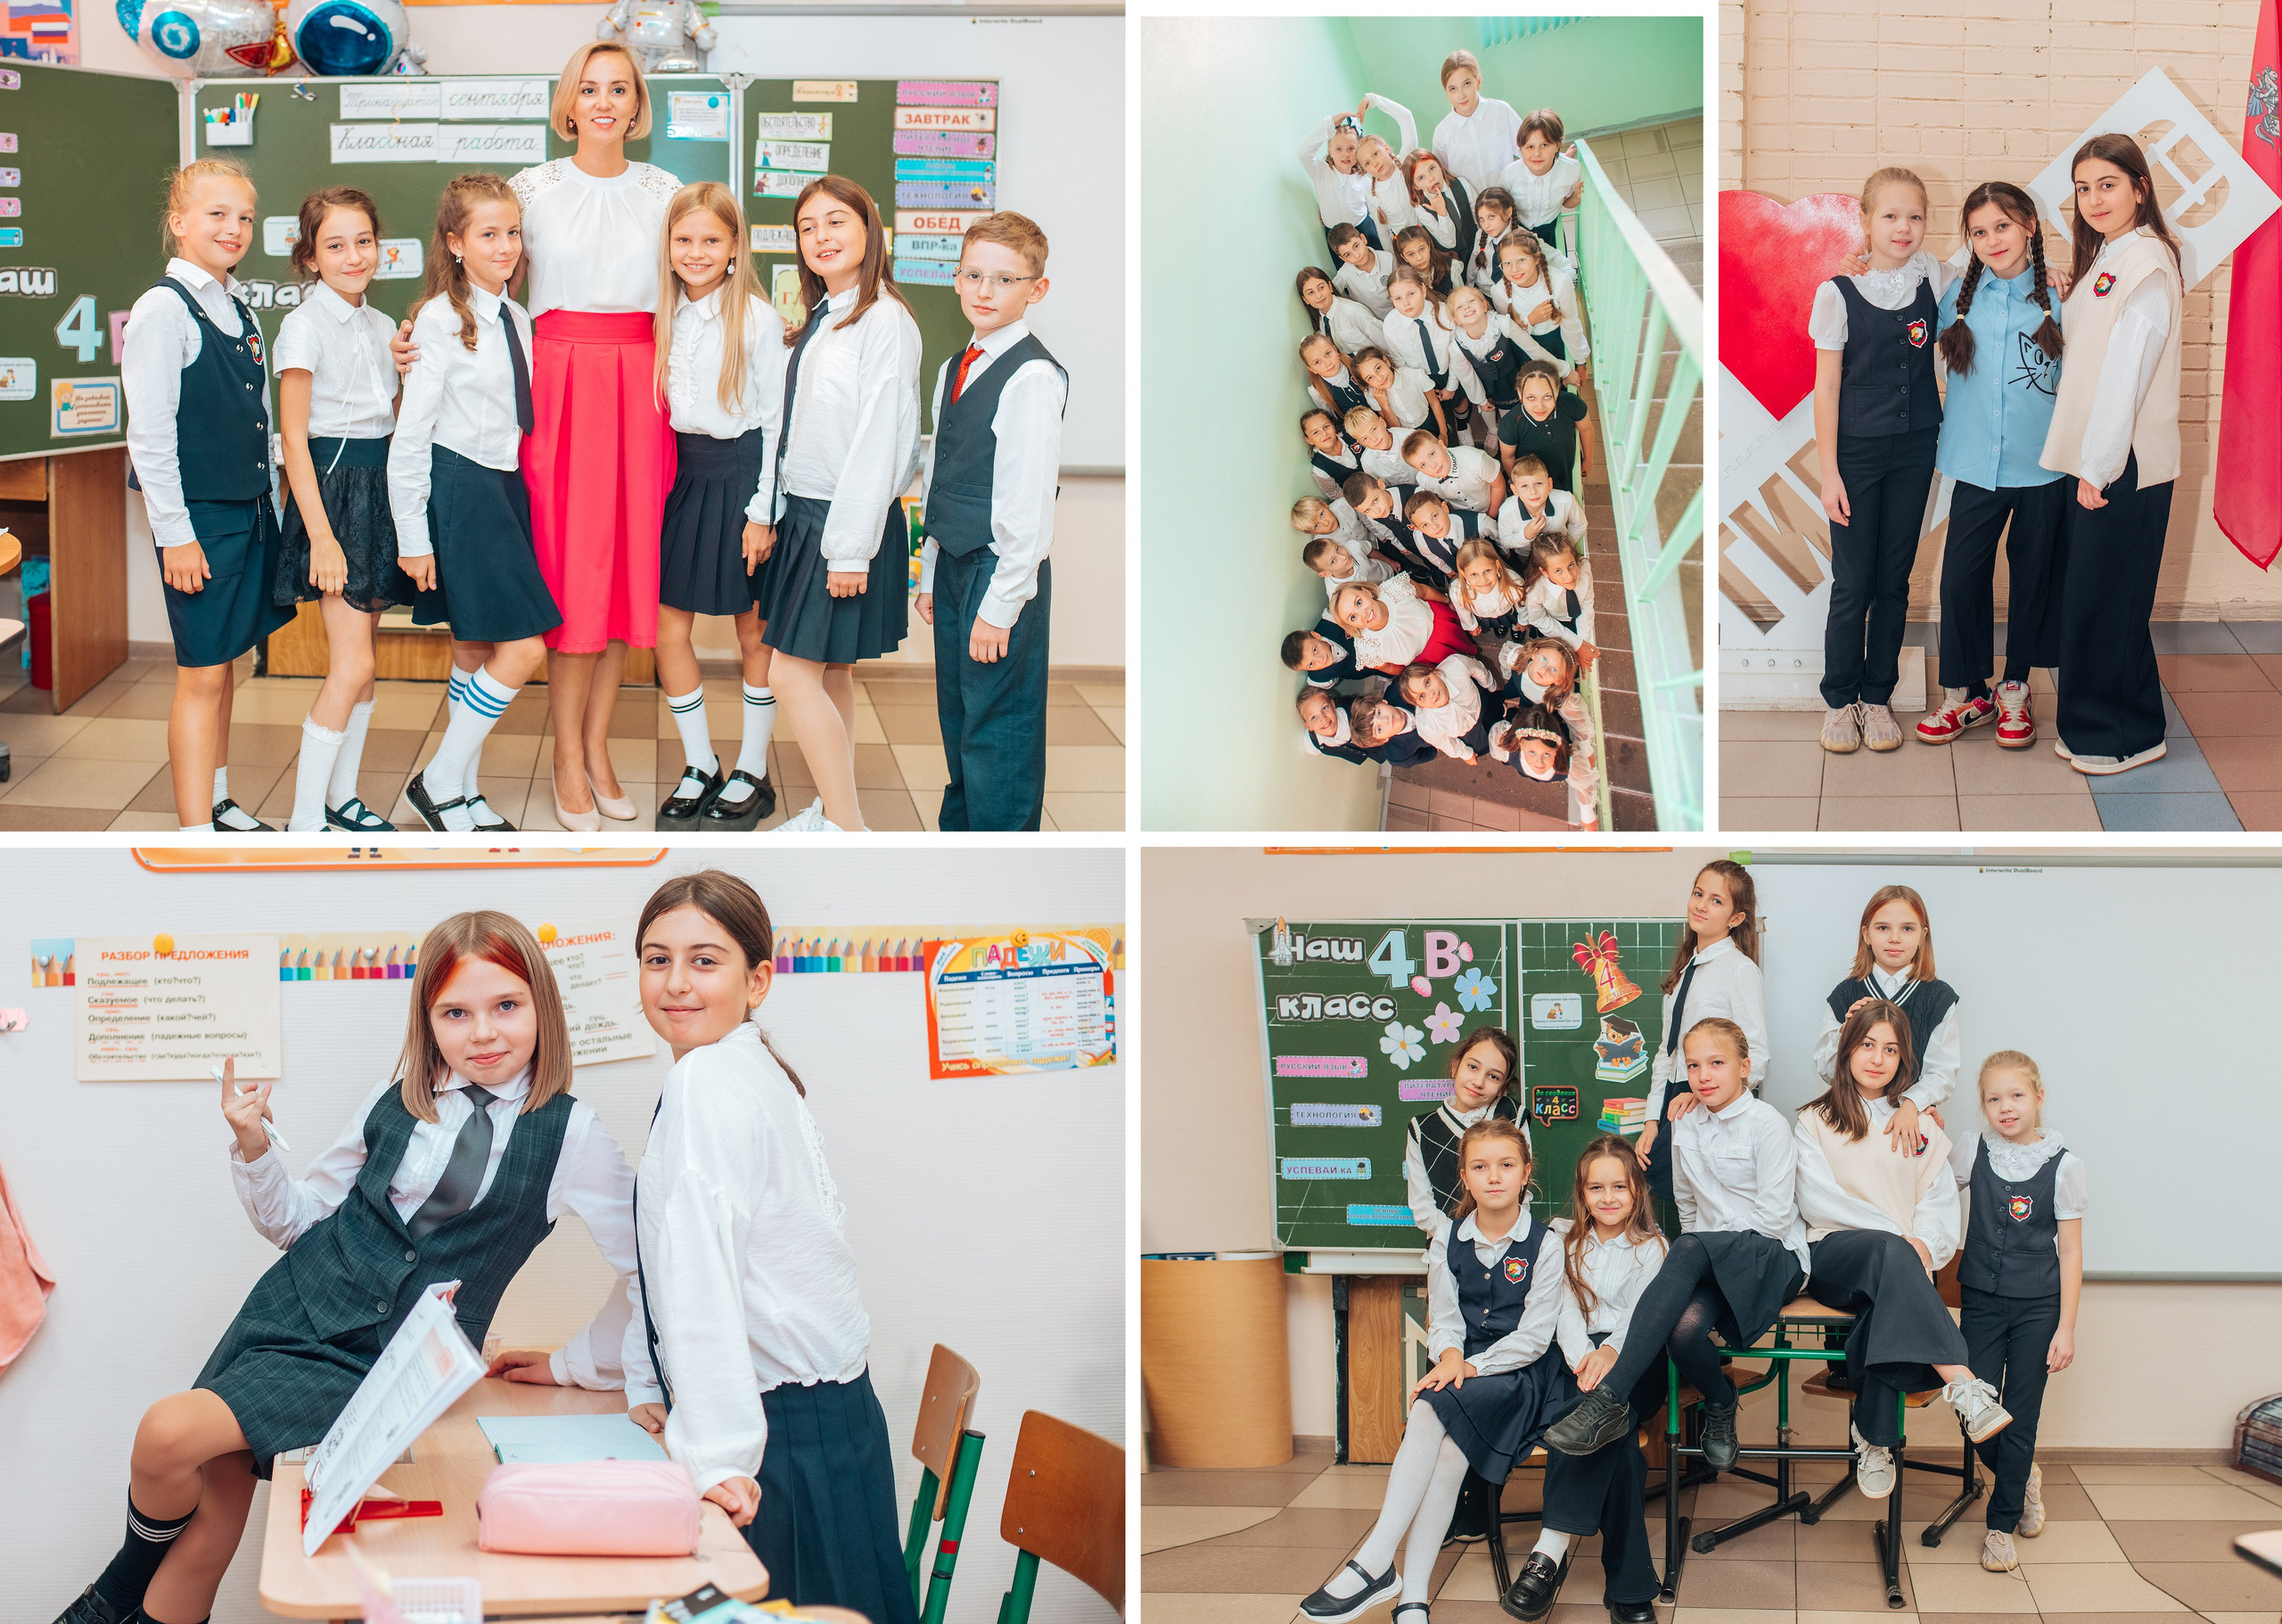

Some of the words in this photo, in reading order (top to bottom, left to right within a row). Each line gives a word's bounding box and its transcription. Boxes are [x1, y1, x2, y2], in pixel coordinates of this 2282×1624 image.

[449, 82, 546, 115] сентября
[904, 113, 972, 125] ЗАВТРАК
[338, 127, 435, 152] Классная
[452, 127, 538, 159] работа
[901, 191, 969, 200] ТЕХНОЛОГИЯ
[914, 217, 961, 231] ОБЕД
[912, 240, 957, 251] ВПР-ка
[0, 270, 54, 295] аш
[55, 295, 104, 363] 4
[1291, 935, 1363, 962] Наш
[101, 951, 151, 961] РАЗБОР
[154, 950, 249, 961] ПРЕДЛОЖЕНИЯ
[567, 953, 584, 962] кто?
[971, 941, 1066, 971] ПАДЕЖИ
[568, 962, 585, 970] что?
[1599, 959, 1615, 989] 4
[87, 978, 148, 987] Подлежащее
[154, 977, 201, 986] (кто?что?)
[570, 979, 603, 989] делает?
[88, 997, 138, 1005] Сказуемое
[165, 995, 206, 1004] делать?)
[1278, 995, 1396, 1020] класс
[88, 1014, 151, 1023] Определение
[157, 1013, 217, 1022] (какой?чей?)
[584, 1021, 620, 1031] дождь.
[88, 1033, 145, 1041] Дополнение
[151, 1033, 202, 1041] (падежные
[204, 1031, 248, 1040] вопросы)
[579, 1033, 632, 1046] остальные
[1552, 1096, 1559, 1104] 4
